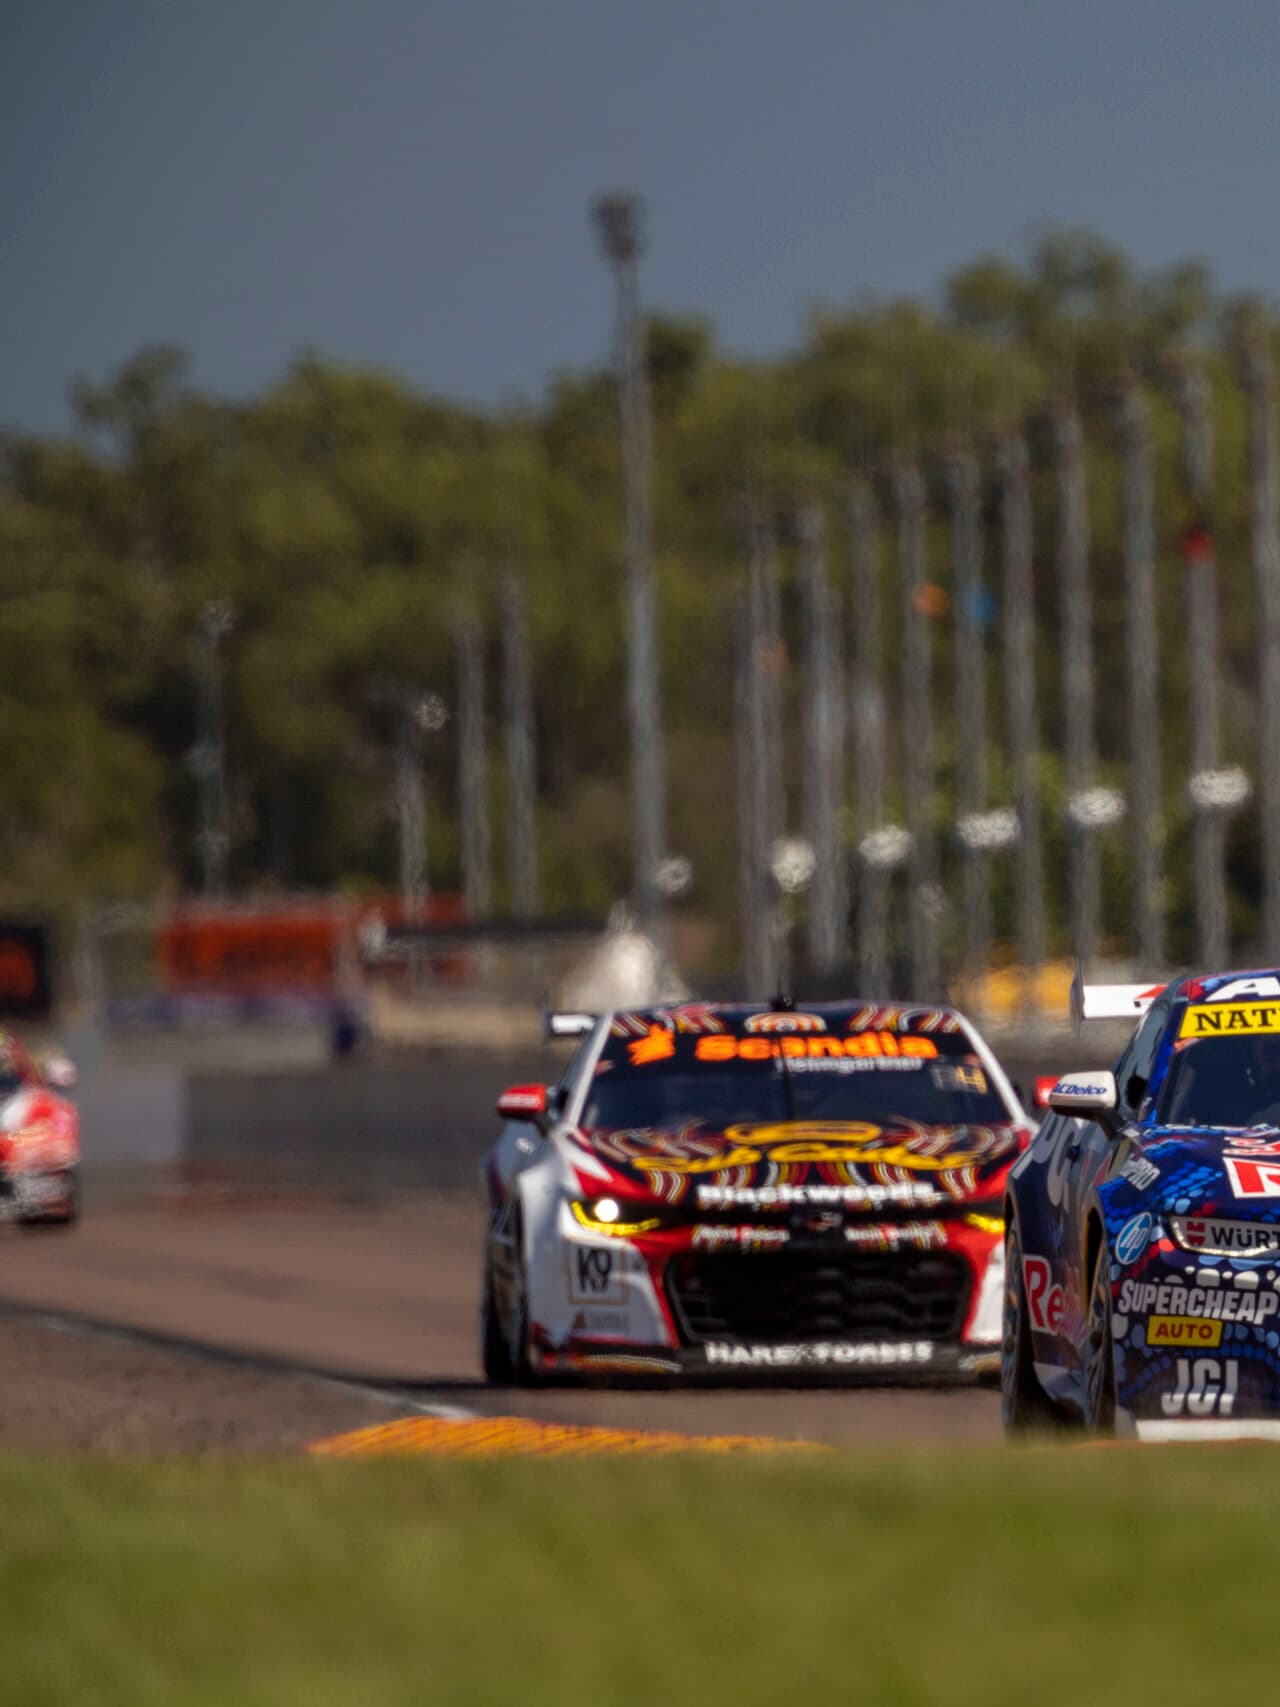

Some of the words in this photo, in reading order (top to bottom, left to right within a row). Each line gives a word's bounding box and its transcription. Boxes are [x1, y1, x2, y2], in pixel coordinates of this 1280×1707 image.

[1053, 1083, 1107, 1095] ACDelco
[578, 1248, 612, 1293] K9
[1118, 1279, 1278, 1325] SUPERCHEAP
[1156, 1323, 1213, 1340] AUTO
